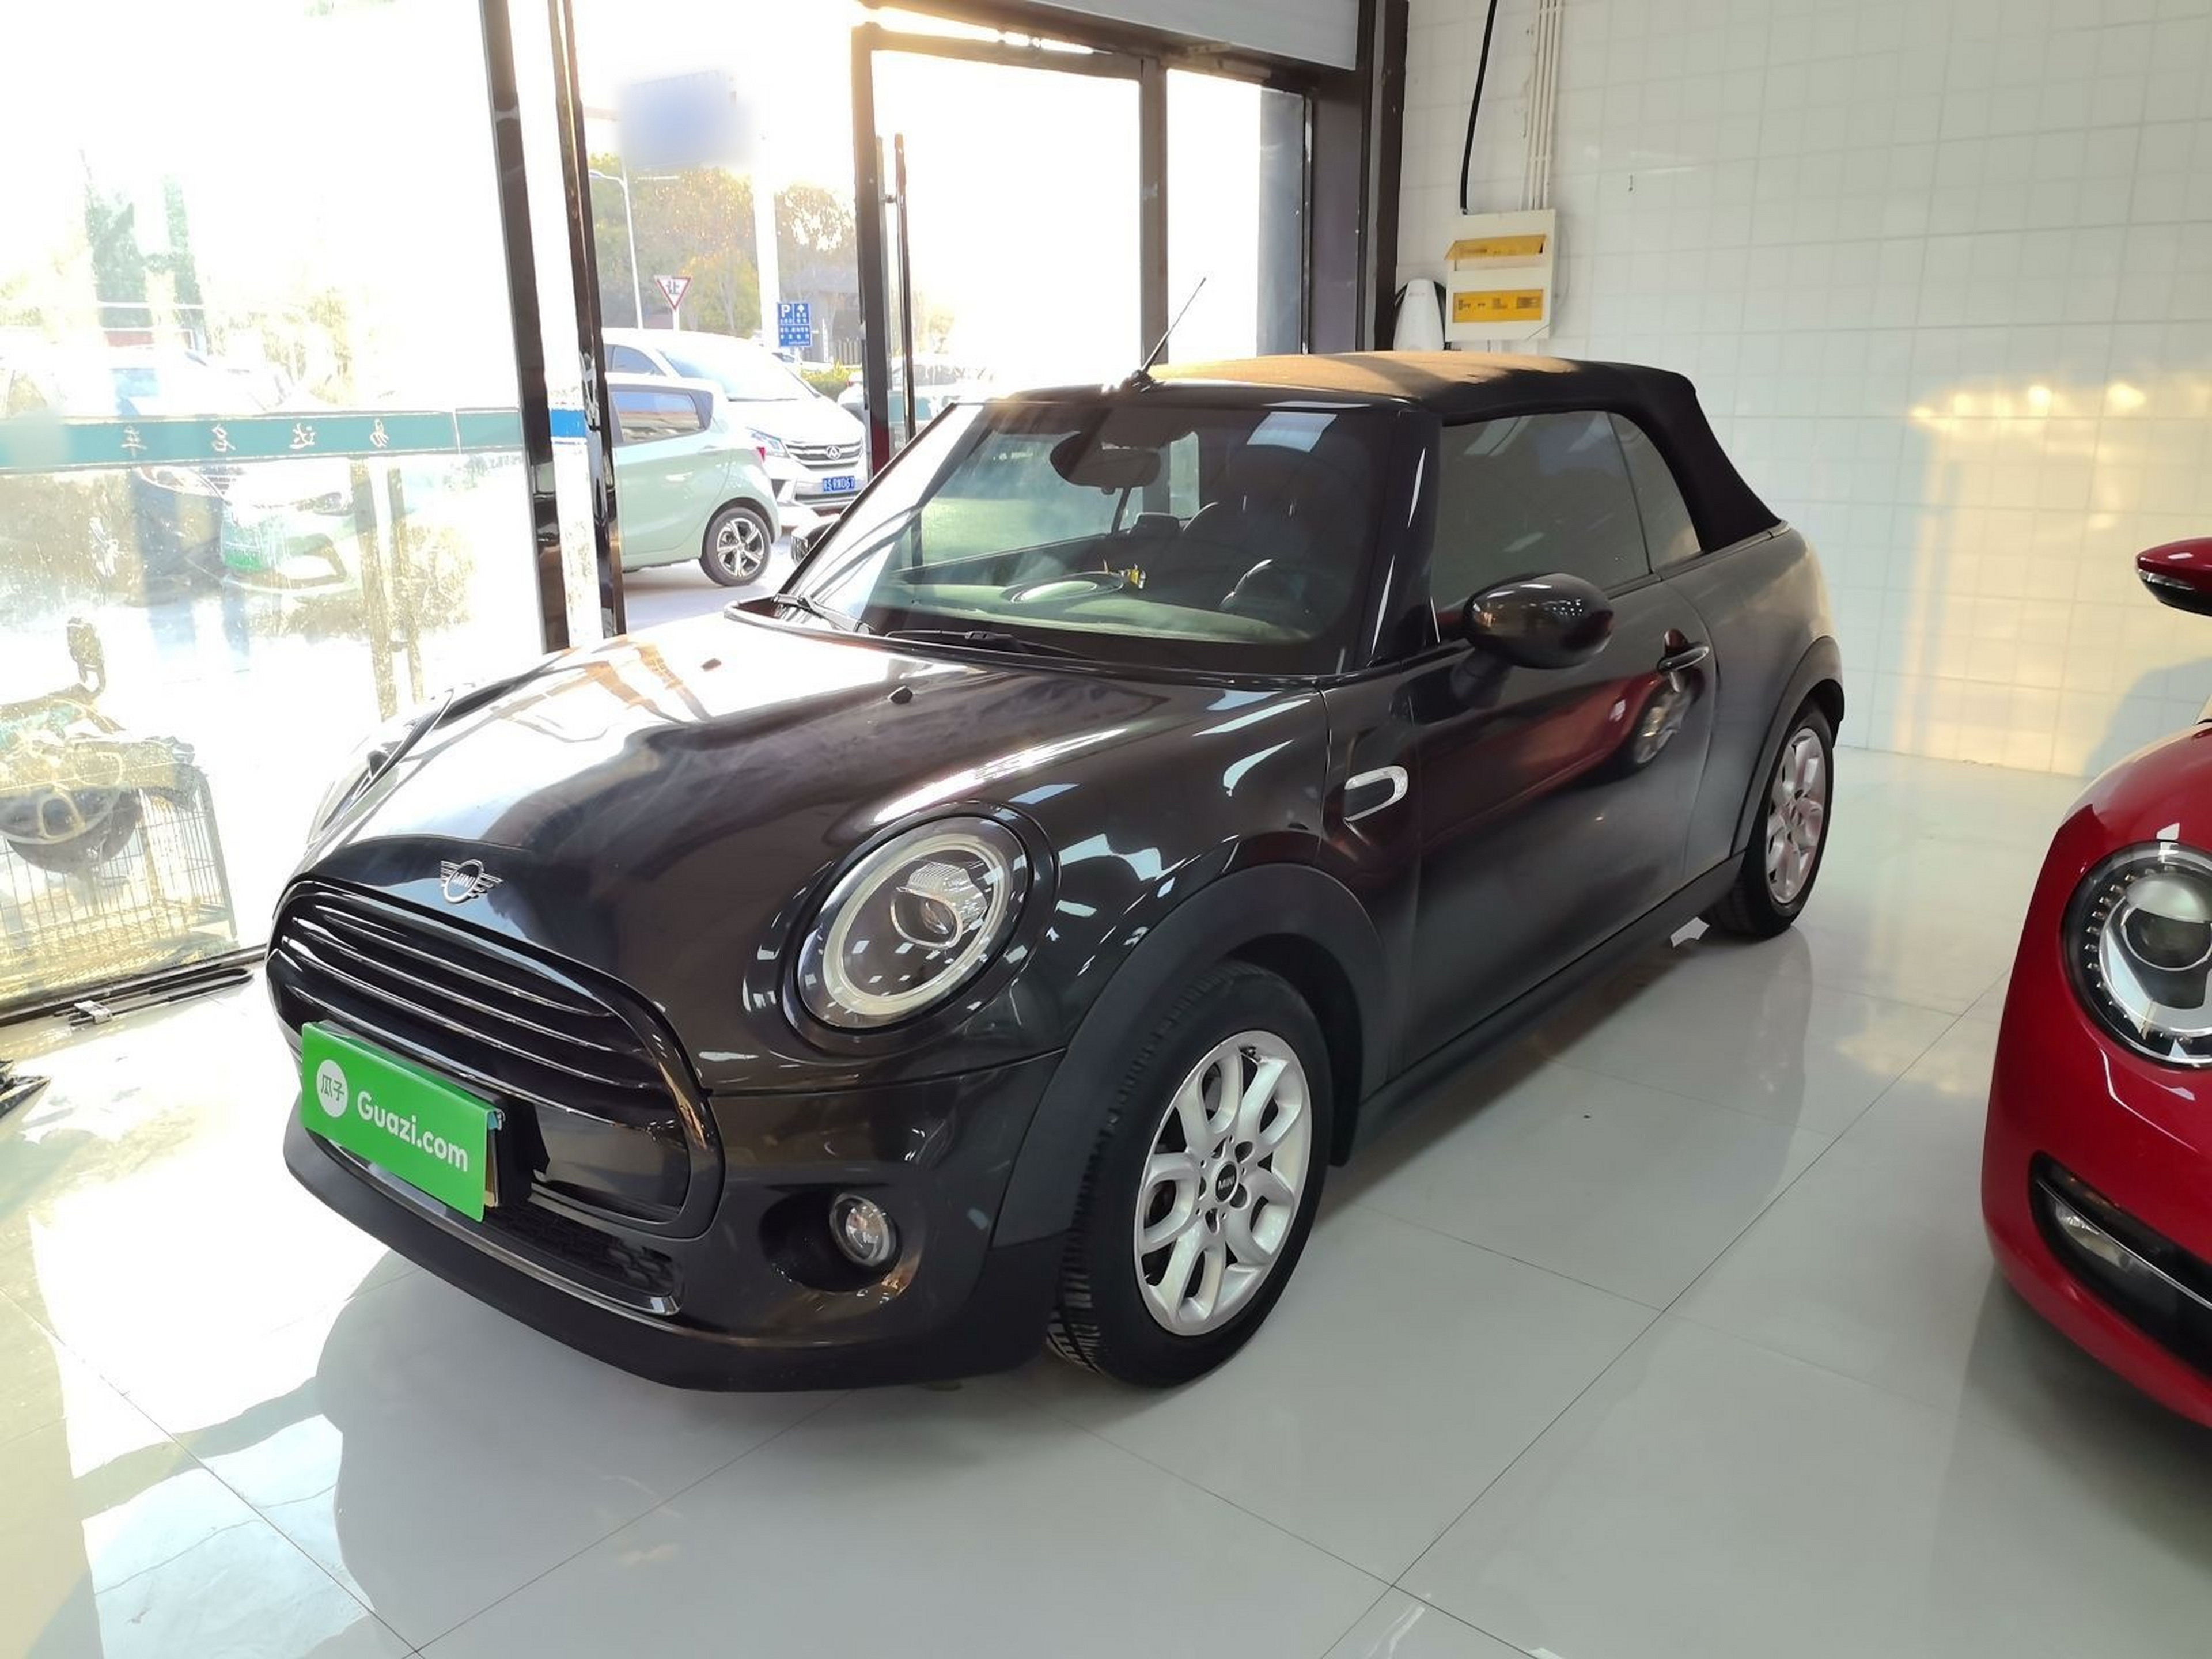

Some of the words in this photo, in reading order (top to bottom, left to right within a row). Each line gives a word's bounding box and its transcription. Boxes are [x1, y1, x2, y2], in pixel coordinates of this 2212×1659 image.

[666, 281, 680, 295] 让
[781, 304, 790, 318] P
[452, 872, 475, 888] MINI
[321, 1074, 344, 1103] 瓜子
[357, 1090, 468, 1172] Guazi.com
